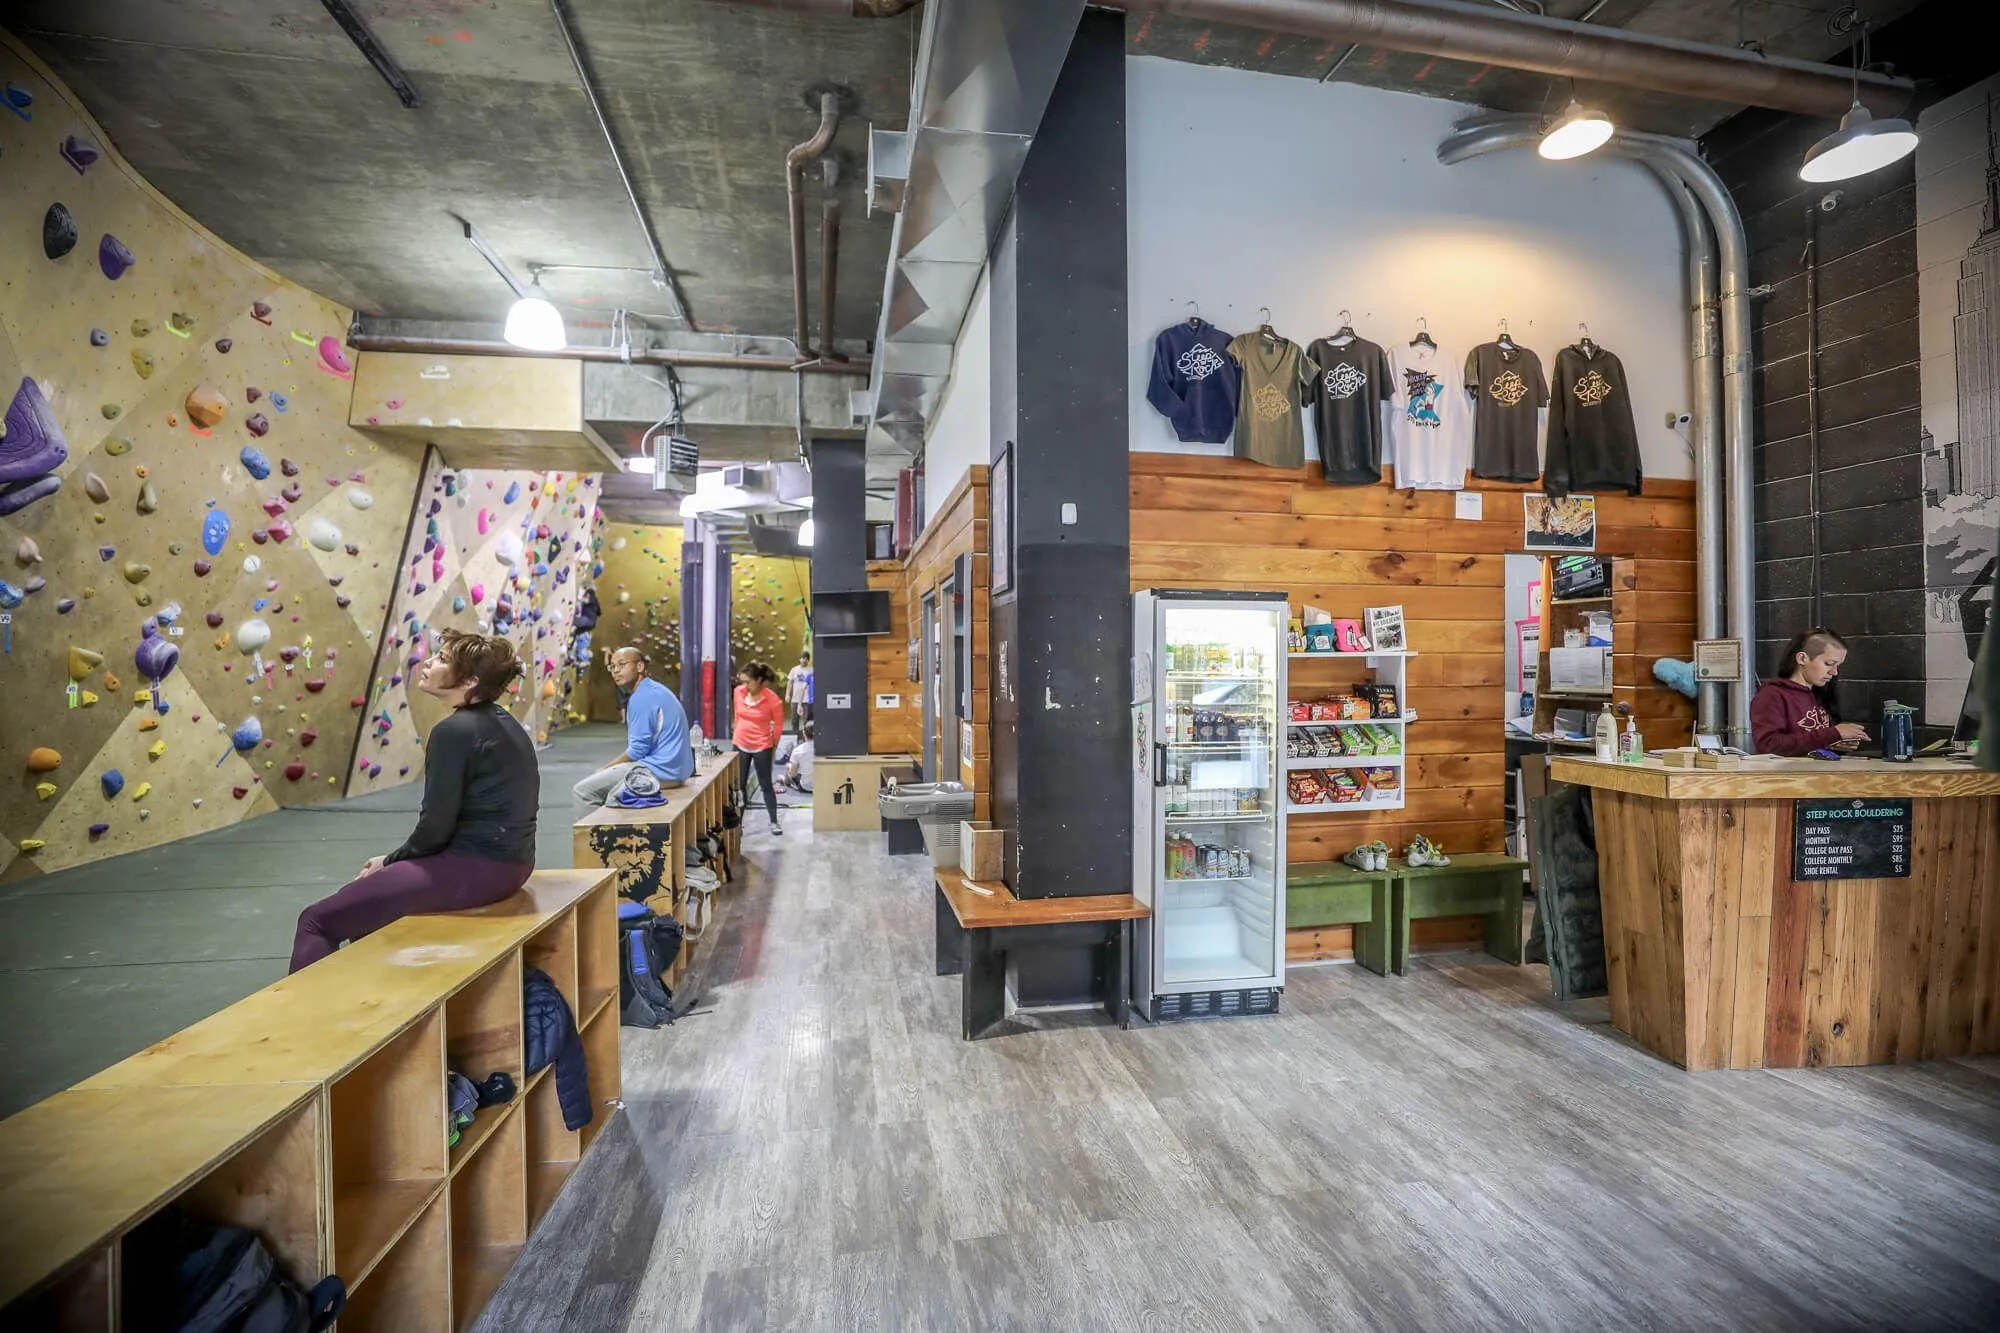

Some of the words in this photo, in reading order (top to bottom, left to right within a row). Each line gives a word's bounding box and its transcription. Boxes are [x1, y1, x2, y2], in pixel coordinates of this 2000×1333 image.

[1806, 810, 1828, 819] STEEP
[1829, 809, 1853, 818] ROCK
[1855, 808, 1904, 818] BOULDERING
[1805, 827, 1817, 835] DAY
[1817, 826, 1831, 834] PASS
[1805, 836, 1830, 845] MONTHLY
[1804, 846, 1827, 855] COLLEGE
[1828, 846, 1839, 854] DAY
[1839, 845, 1853, 854] PASS
[1804, 856, 1827, 865] COLLEGE
[1828, 856, 1853, 864] MONTHLY
[1804, 867, 1818, 875] SHOE
[1819, 866, 1838, 875] RENTAL
[1894, 865, 1903, 873] $5
